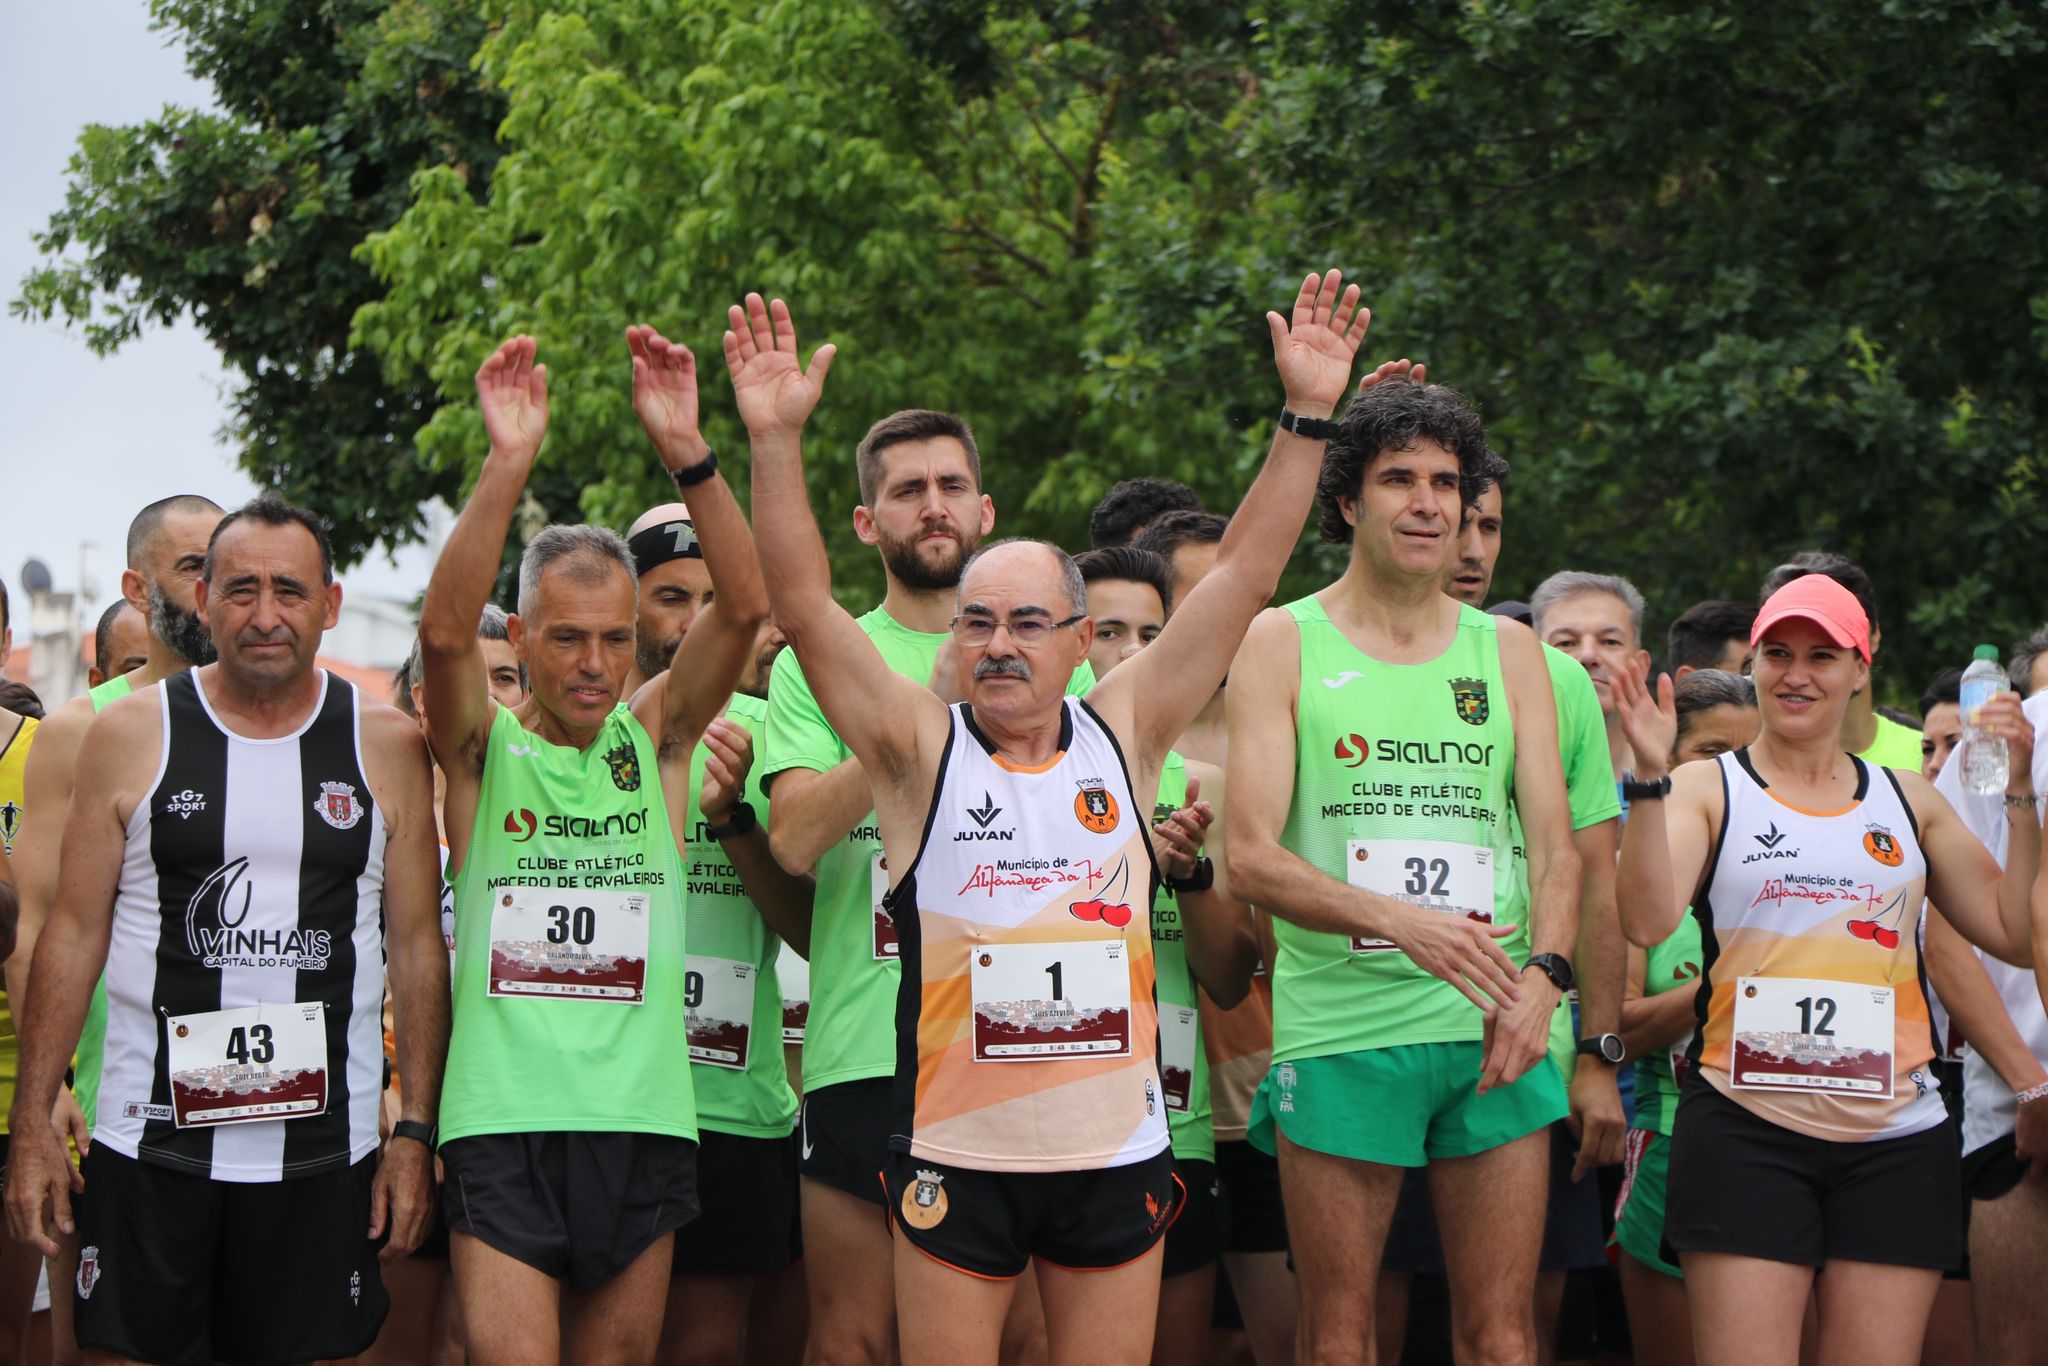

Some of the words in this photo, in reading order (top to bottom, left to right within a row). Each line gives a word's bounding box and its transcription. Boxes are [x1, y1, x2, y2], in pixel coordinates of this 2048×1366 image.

[1352, 782, 1403, 797] CLUBE
[1410, 782, 1481, 801] ATLÉTICO
[167, 801, 207, 813] SPORT
[1321, 802, 1387, 819] MACEDO
[1393, 803, 1414, 816] DE
[953, 831, 1013, 842] JUVAN
[517, 857, 568, 870] CLUBE
[575, 853, 644, 872] ATLÉTICO
[997, 858, 1050, 871] Município
[1053, 858, 1069, 867] de
[1742, 850, 1798, 864] JUVAN
[487, 876, 550, 891] MACEDO
[557, 876, 578, 888] DE
[584, 872, 665, 889] CAVALEIROS
[1404, 857, 1450, 896] 32
[1785, 874, 1836, 888] Município
[1839, 877, 1854, 887] de
[546, 905, 596, 946] 30
[201, 928, 332, 959] VINHAIS
[203, 956, 255, 967] CAPITAL
[258, 958, 277, 967] DO
[279, 958, 328, 970] FUMEIRO
[684, 971, 704, 1008] 9
[1045, 961, 1063, 1000] 1
[1795, 996, 1838, 1036] 12
[225, 1024, 275, 1065] 43
